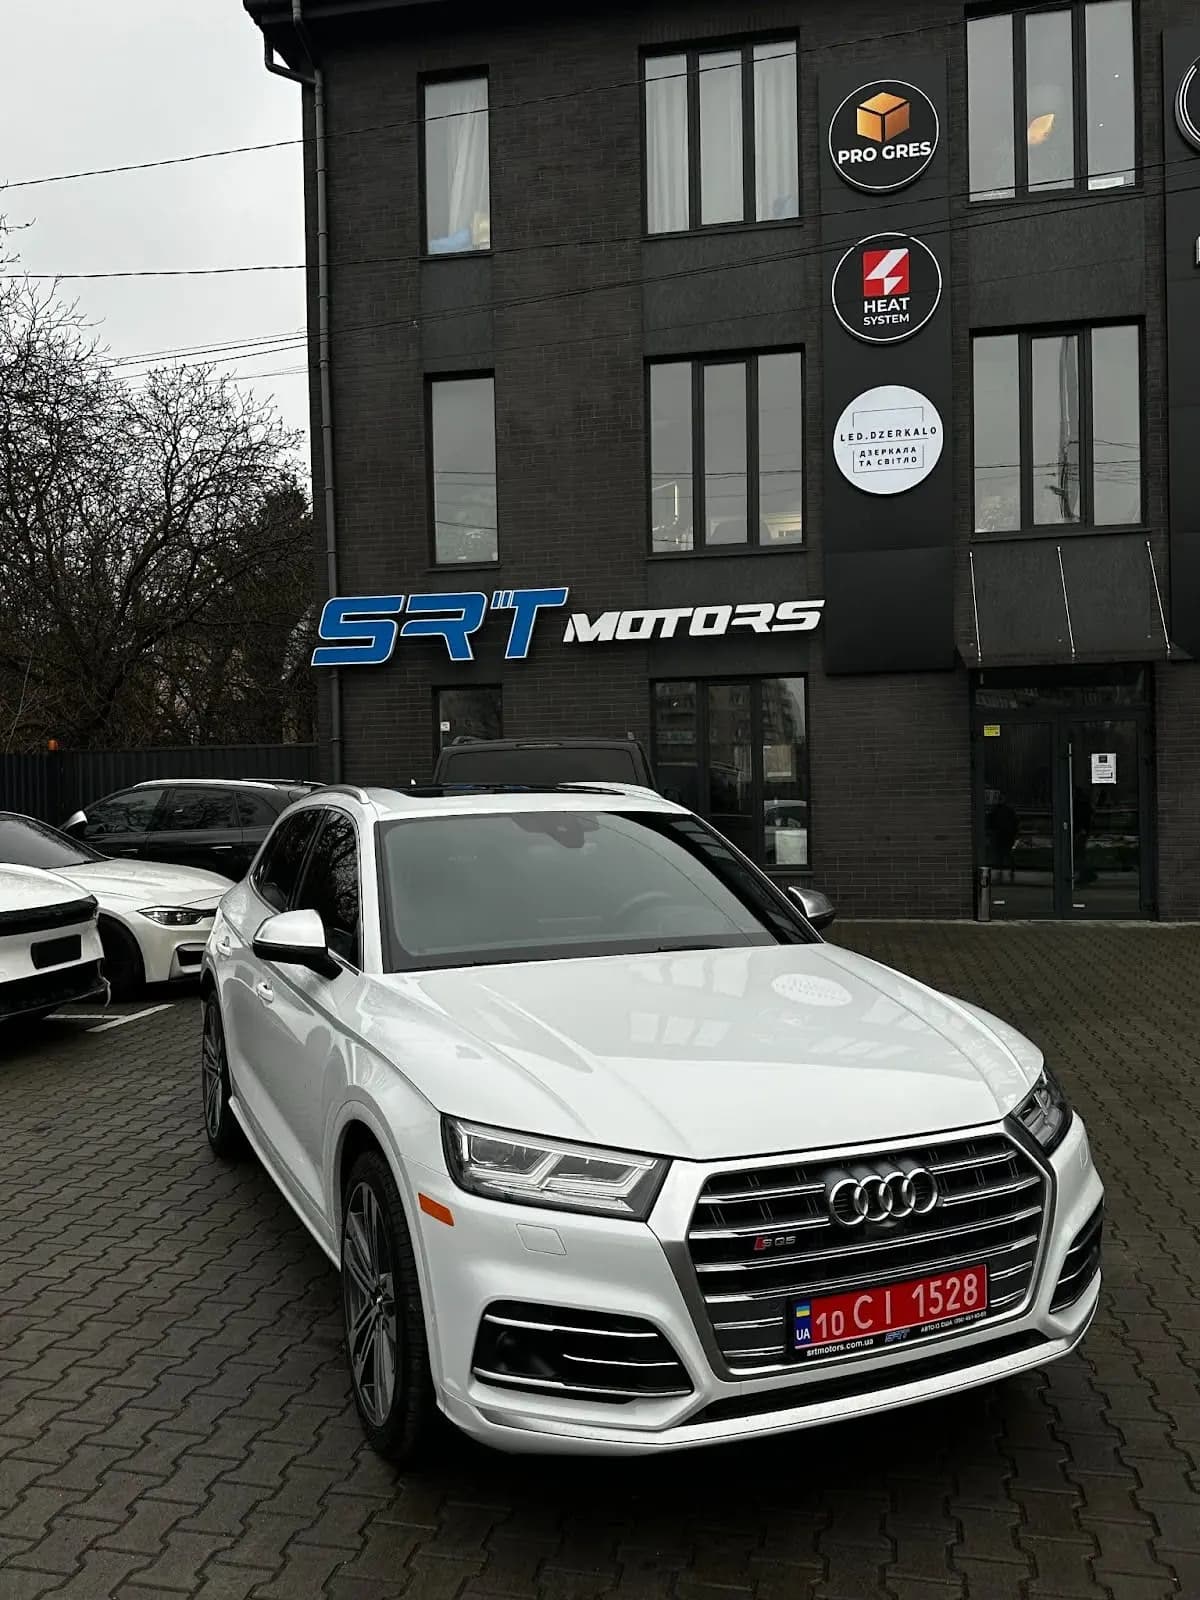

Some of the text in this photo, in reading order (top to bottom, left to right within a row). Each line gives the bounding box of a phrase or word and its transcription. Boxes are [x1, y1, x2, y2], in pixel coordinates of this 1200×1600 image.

[838, 141, 932, 165] PRO GRES
[864, 297, 910, 314] HEAT
[863, 313, 910, 326] SYSTEM
[840, 426, 937, 442] LED.DZERKALO
[859, 446, 917, 458] ДЗЕРКАЛА
[877, 456, 917, 466] СВІТЛО
[310, 586, 826, 667] SRT MOTORS
[816, 1310, 845, 1339] 10
[911, 1273, 978, 1318] 1528
[795, 1328, 811, 1341] UA
[806, 1338, 874, 1357] srtmotors.com.ua
